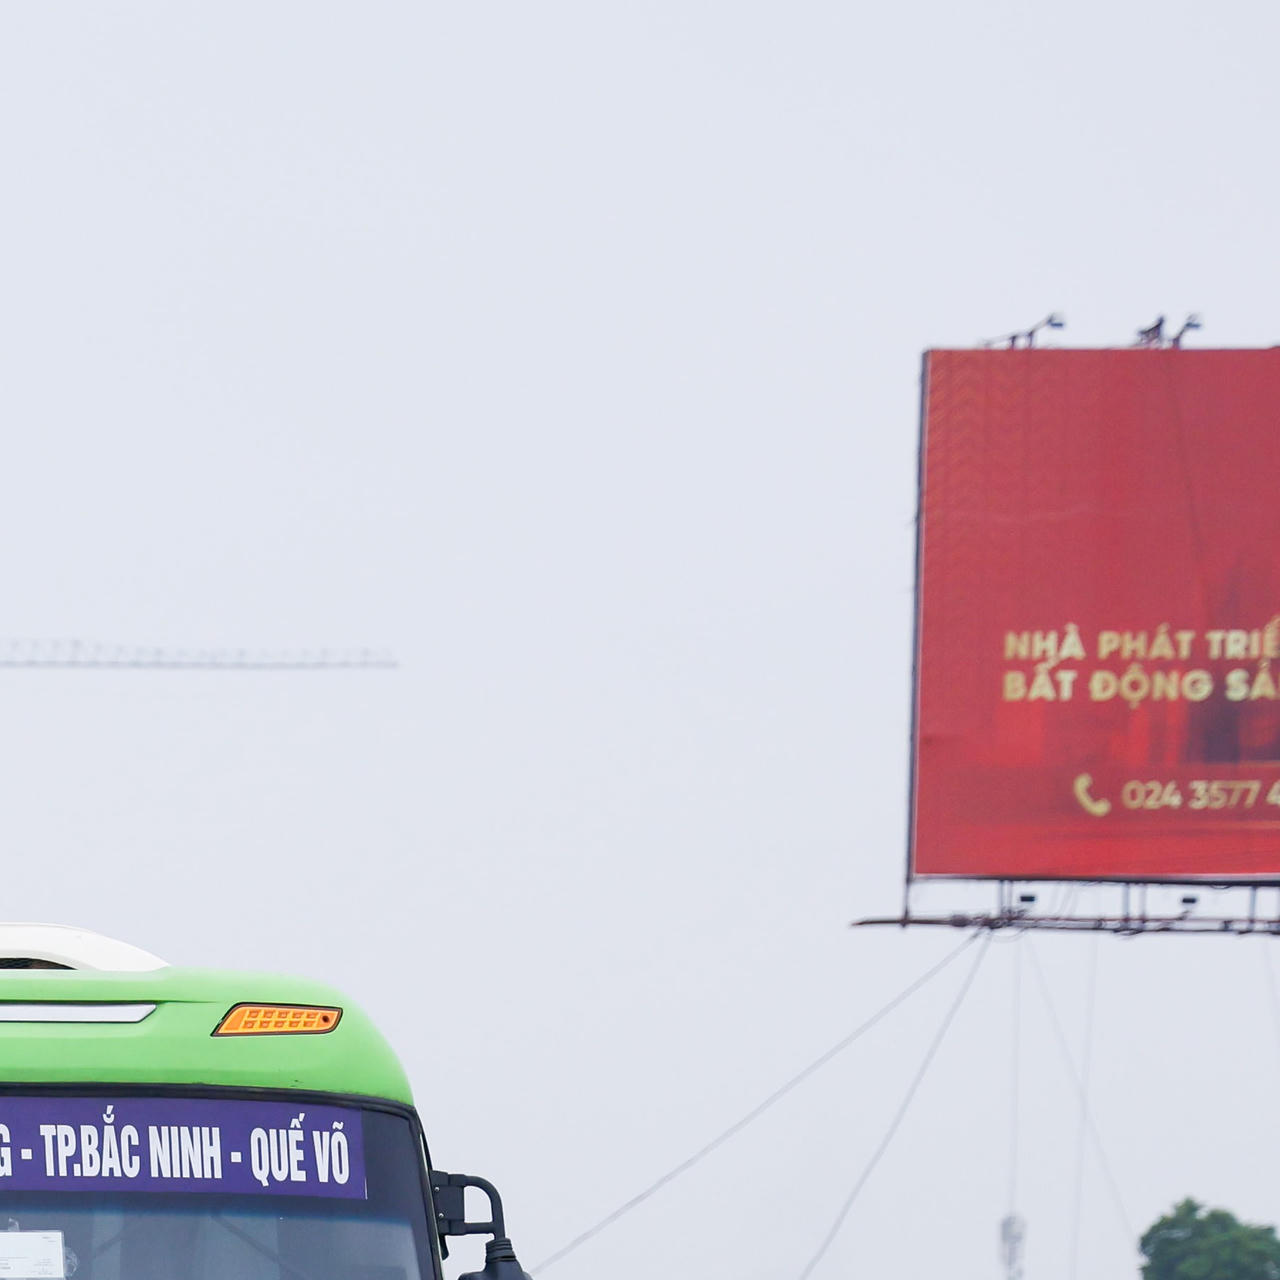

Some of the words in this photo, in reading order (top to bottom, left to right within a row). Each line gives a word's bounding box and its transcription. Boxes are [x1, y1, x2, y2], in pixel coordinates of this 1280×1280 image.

[1004, 622, 1086, 660] NHÀ
[1097, 622, 1195, 660] PHÁT
[1003, 654, 1078, 701] BẤT
[1090, 662, 1214, 710] ĐỘNG
[1225, 659, 1280, 701] SẢ
[1122, 780, 1182, 810] 024
[1189, 780, 1261, 810] 3577
[40, 1104, 140, 1178] TP.BẮC
[148, 1125, 223, 1179] NINH
[250, 1112, 307, 1187] QUẾ
[312, 1121, 350, 1185] VÕ
